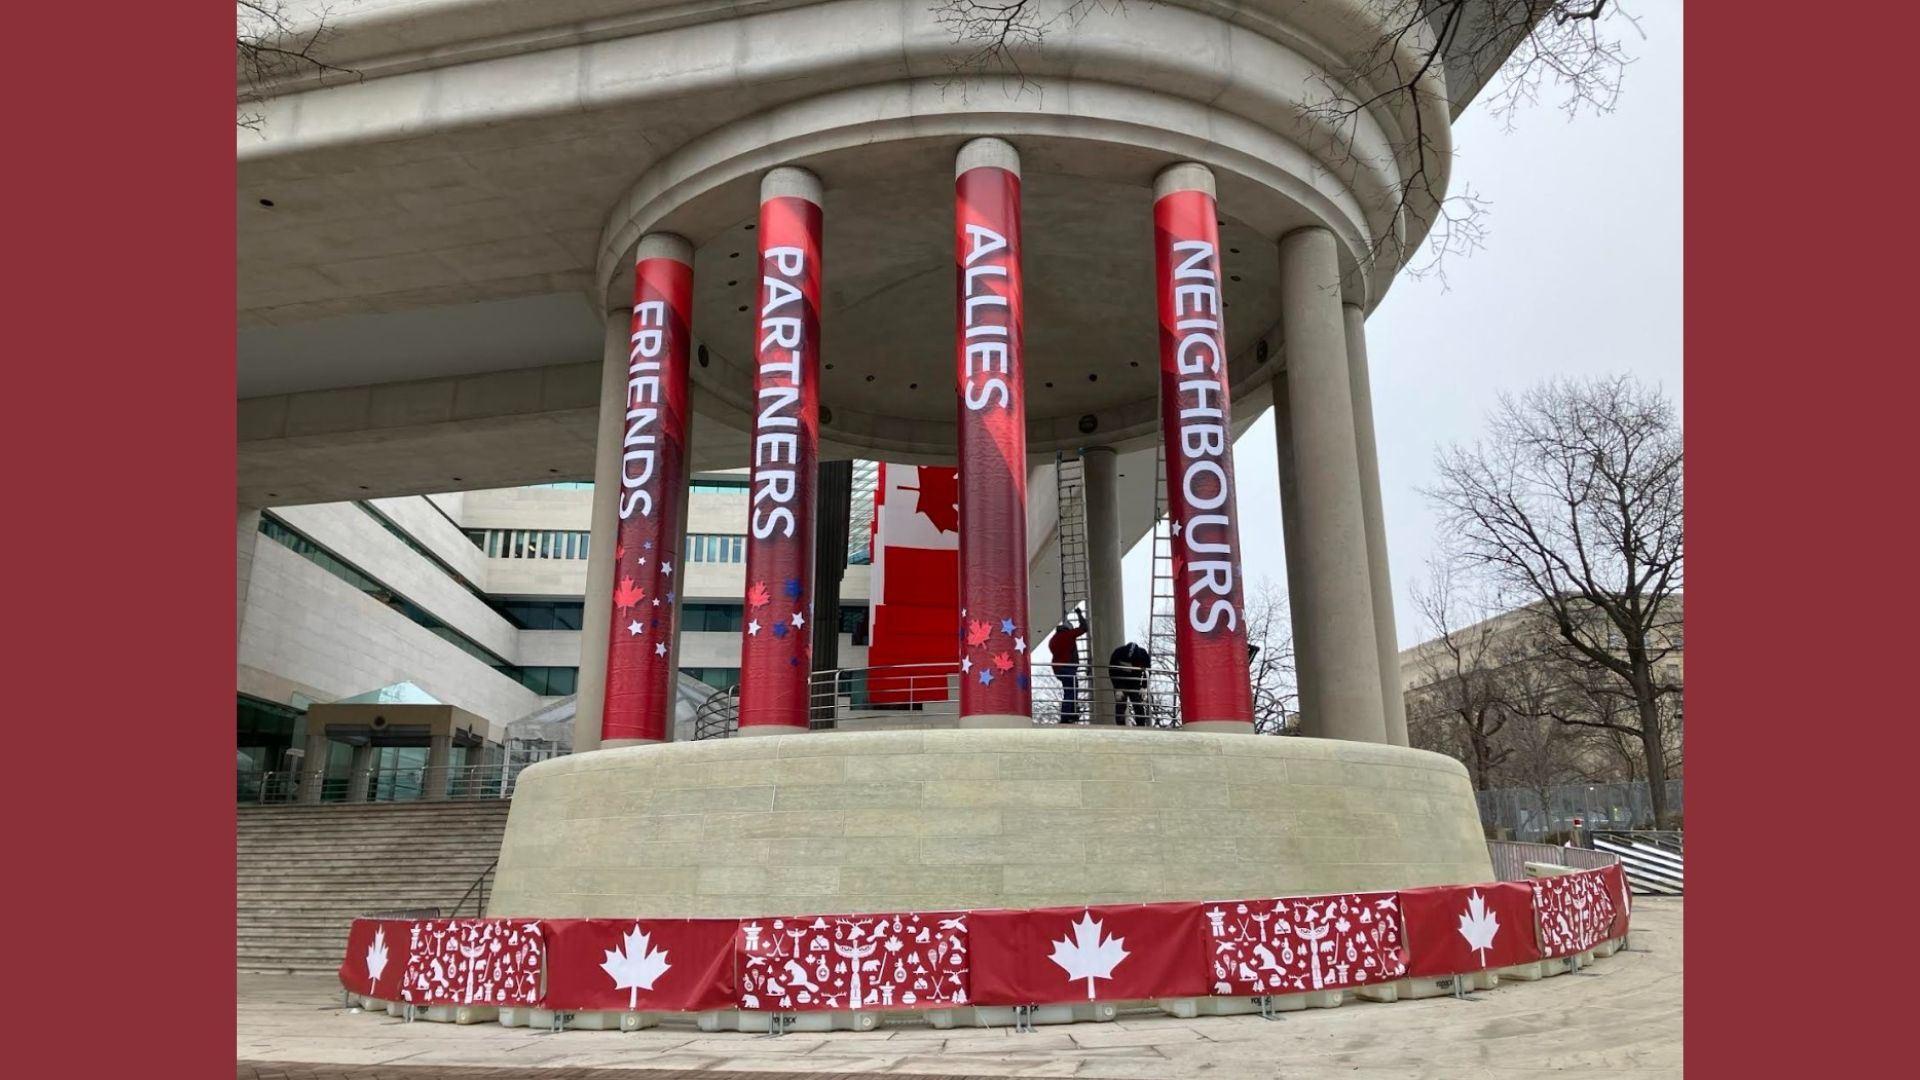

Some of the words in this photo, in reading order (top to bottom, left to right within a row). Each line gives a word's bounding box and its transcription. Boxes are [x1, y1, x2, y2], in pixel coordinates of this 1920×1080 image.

[619, 300, 665, 520] FRIENDS
[753, 245, 805, 540] PARTNERS
[965, 222, 1008, 411] ALLIES
[1173, 240, 1237, 633] NEIGHBOURS
